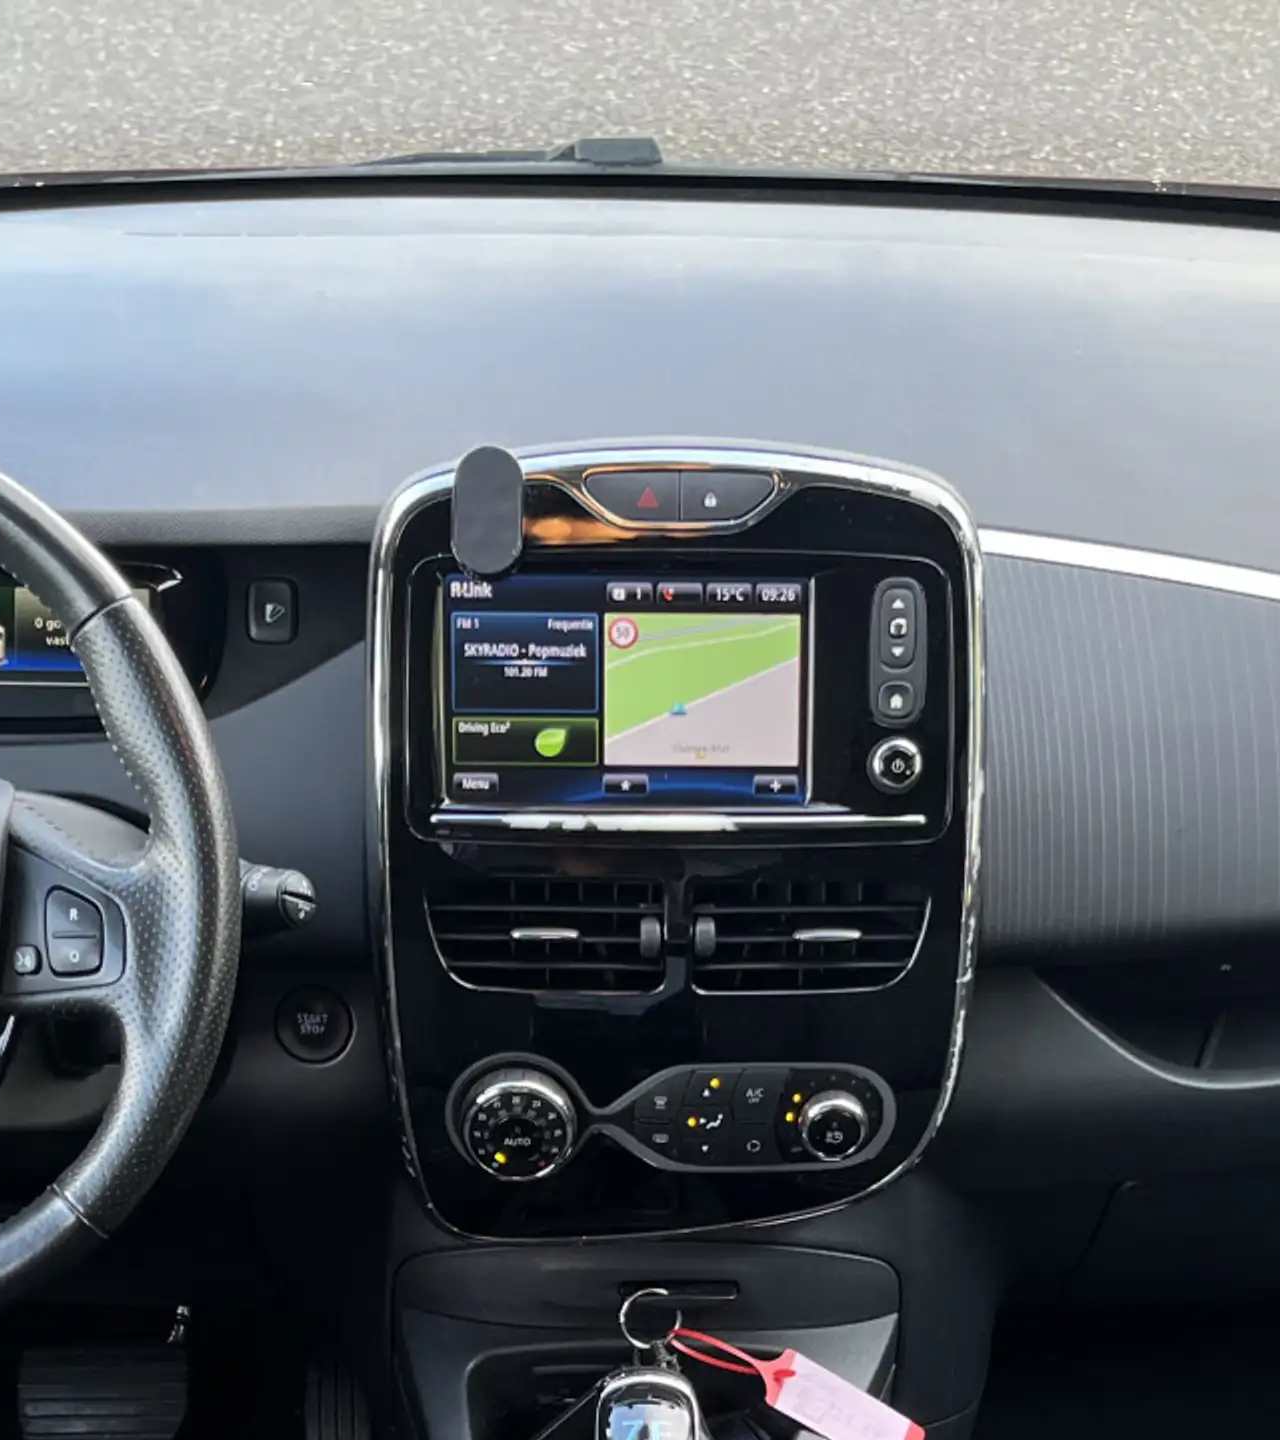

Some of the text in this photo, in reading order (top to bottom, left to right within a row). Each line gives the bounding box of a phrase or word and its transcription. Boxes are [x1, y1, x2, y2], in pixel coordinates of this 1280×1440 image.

[716, 587, 745, 601] 15°C
[34, 617, 43, 629] 0
[464, 643, 519, 657] SKYRADIO
[528, 643, 587, 659] Popmuziek
[458, 722, 489, 736] Driving
[462, 777, 490, 790] Menu
[69, 907, 78, 921] R
[746, 1088, 764, 1098] A/C
[503, 1137, 531, 1147] AUTO
